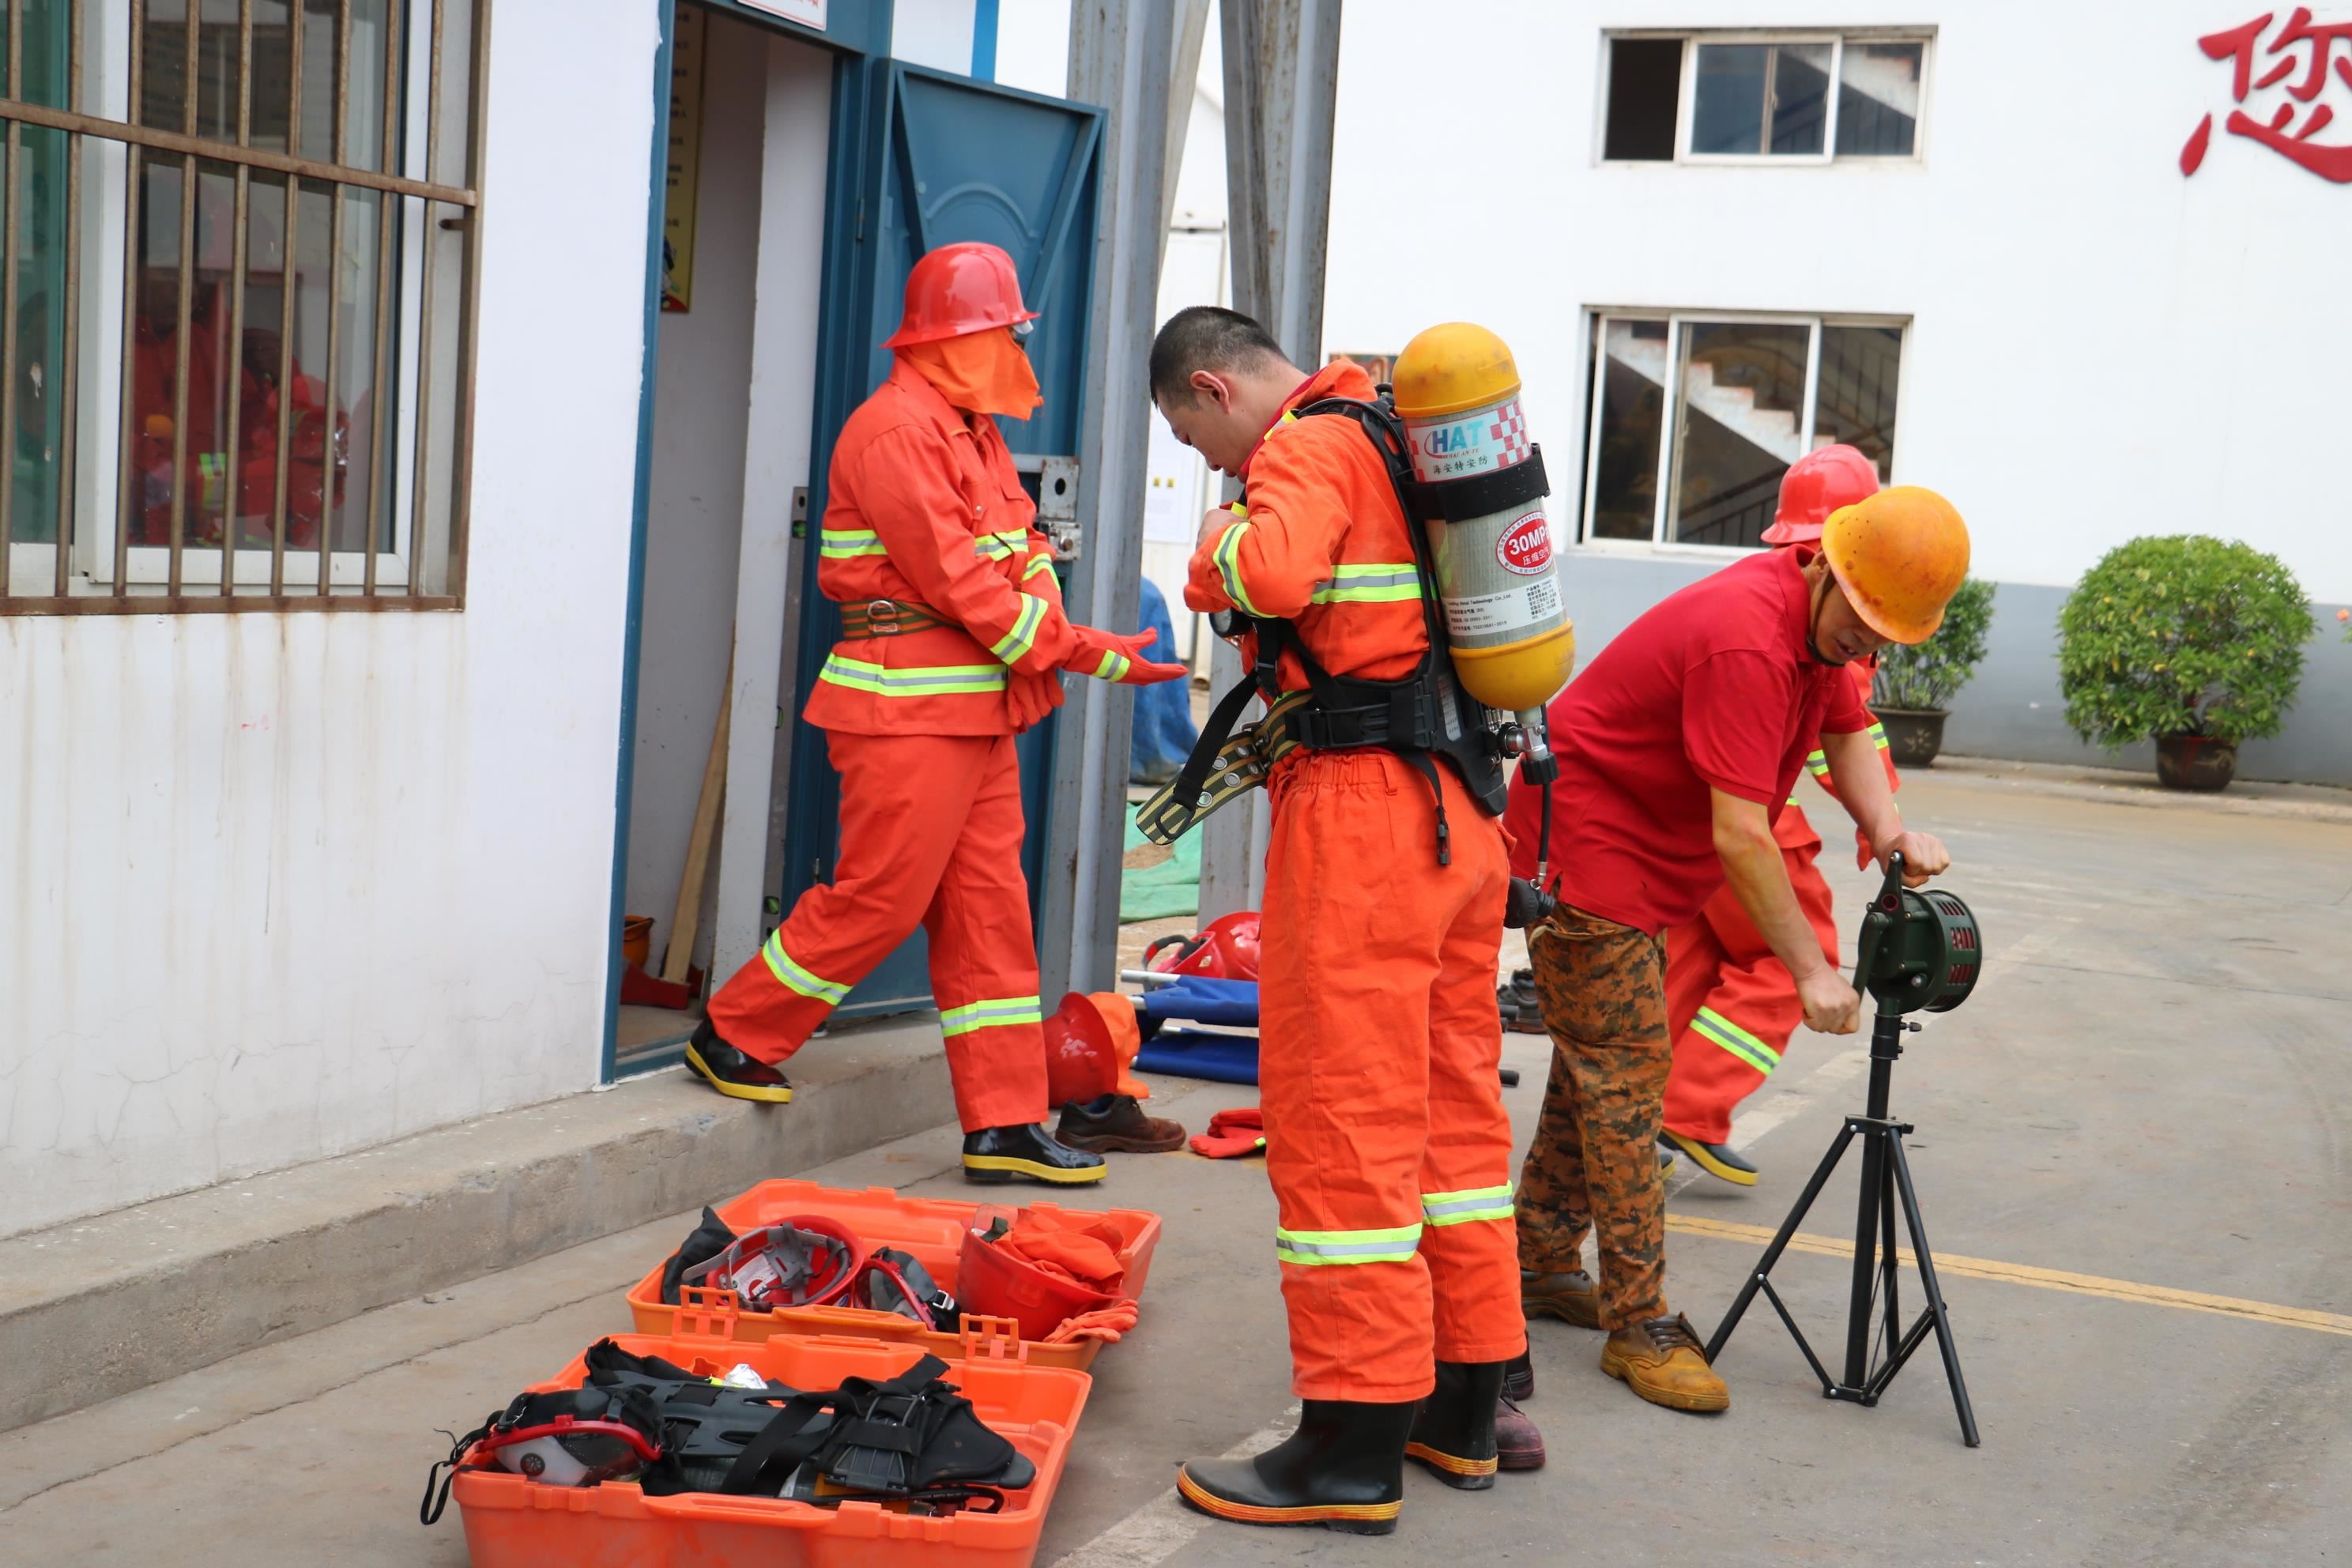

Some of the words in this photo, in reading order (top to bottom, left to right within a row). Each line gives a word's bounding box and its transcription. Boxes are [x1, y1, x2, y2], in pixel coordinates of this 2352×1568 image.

[2179, 6, 2352, 183] 您
[1432, 420, 1483, 454] HAT
[1432, 455, 1488, 475] 海安特安防
